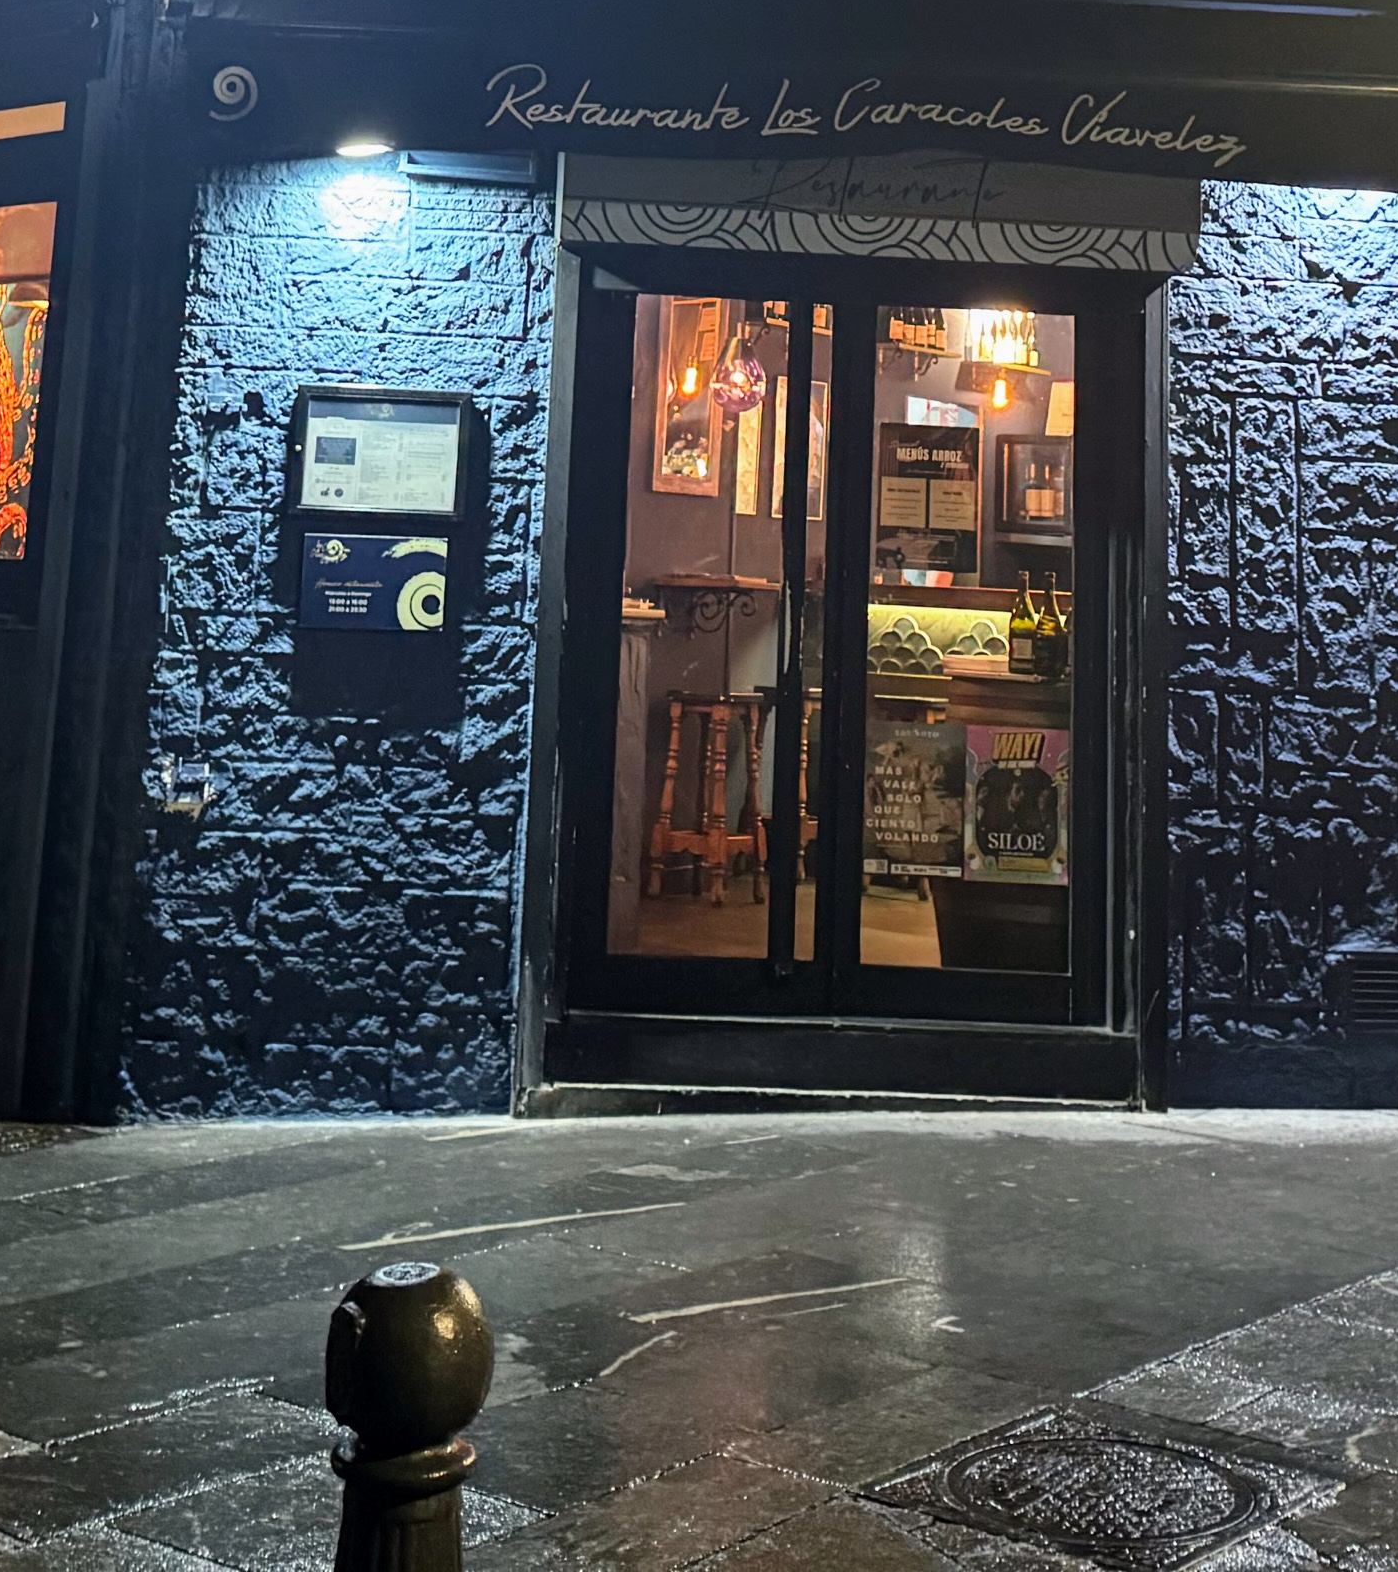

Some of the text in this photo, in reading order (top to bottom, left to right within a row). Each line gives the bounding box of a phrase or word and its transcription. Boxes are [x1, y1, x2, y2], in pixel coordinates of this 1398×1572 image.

[487, 63, 751, 131] Restaurante
[760, 77, 822, 137] Los
[833, 77, 1050, 134] Caracoles
[931, 449, 964, 463] ARROZ
[992, 732, 1044, 760] WAY!
[883, 779, 918, 790] VALE
[886, 793, 922, 804] SOLO
[874, 805, 901, 815] QUE
[866, 818, 916, 829] CIENTO
[875, 831, 939, 844] VOLANDO
[987, 832, 1046, 852] SILOÉ
